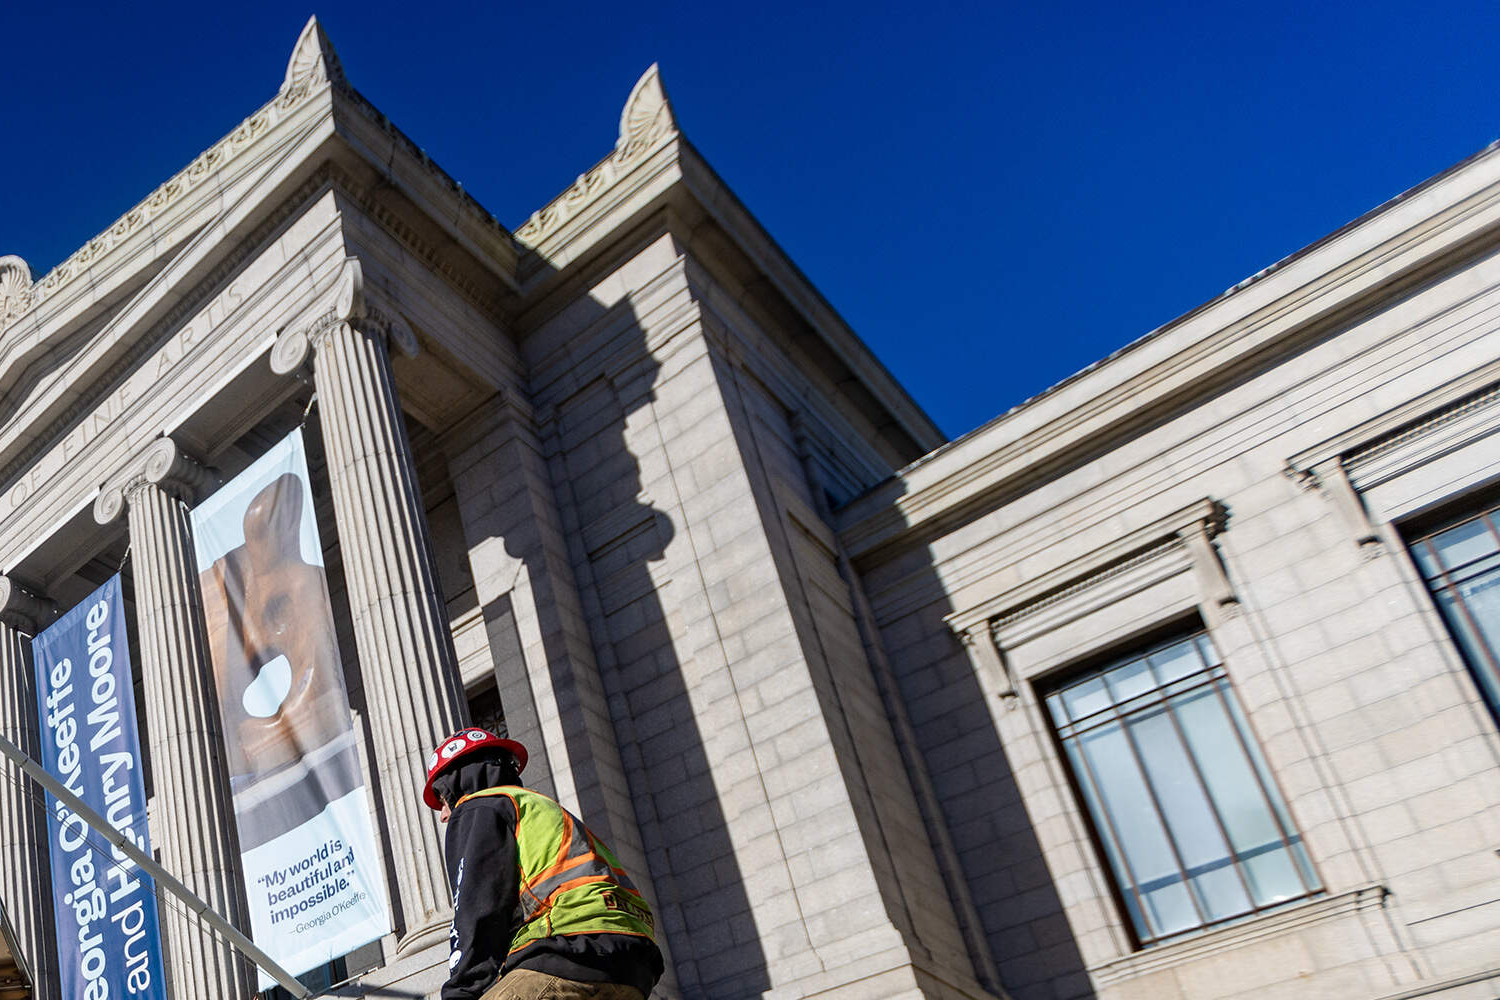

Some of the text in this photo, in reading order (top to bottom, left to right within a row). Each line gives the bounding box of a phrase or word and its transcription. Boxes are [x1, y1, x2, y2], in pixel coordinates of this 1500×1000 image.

[10, 464, 42, 508] OF
[62, 381, 133, 462] FINE
[156, 282, 244, 379] ARTS
[86, 600, 150, 994] and Henry Moore
[289, 843, 329, 876] world
[329, 839, 343, 854] is
[267, 846, 355, 906] beautiful and
